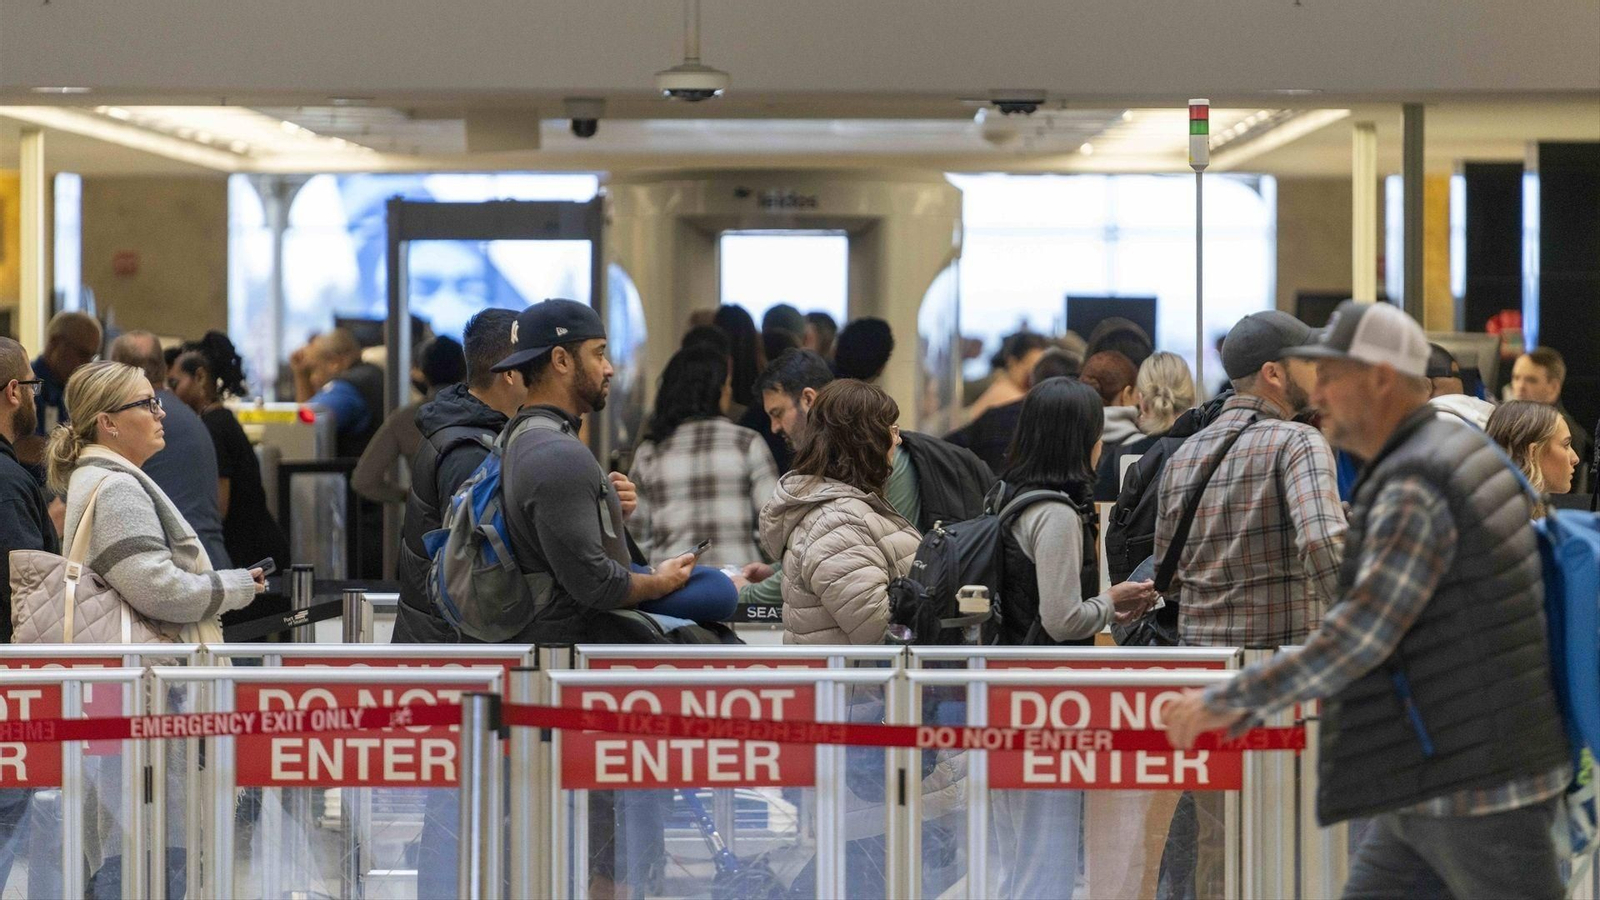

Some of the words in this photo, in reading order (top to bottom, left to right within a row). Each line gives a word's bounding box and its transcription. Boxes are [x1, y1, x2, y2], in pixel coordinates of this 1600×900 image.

[747, 606, 778, 618] SEA
[680, 689, 795, 722] NOT
[1011, 690, 1091, 730] DO
[1111, 690, 1183, 730] NO
[130, 712, 256, 739] EMERGENCY
[261, 710, 305, 733] EXIT
[311, 708, 364, 732] ONLY
[916, 726, 956, 748] DO
[962, 727, 1014, 749] NOT
[1024, 729, 1113, 751] ENTER
[271, 738, 457, 781] ENTER
[595, 739, 782, 783] ENTER
[1023, 750, 1210, 784] ENTER
